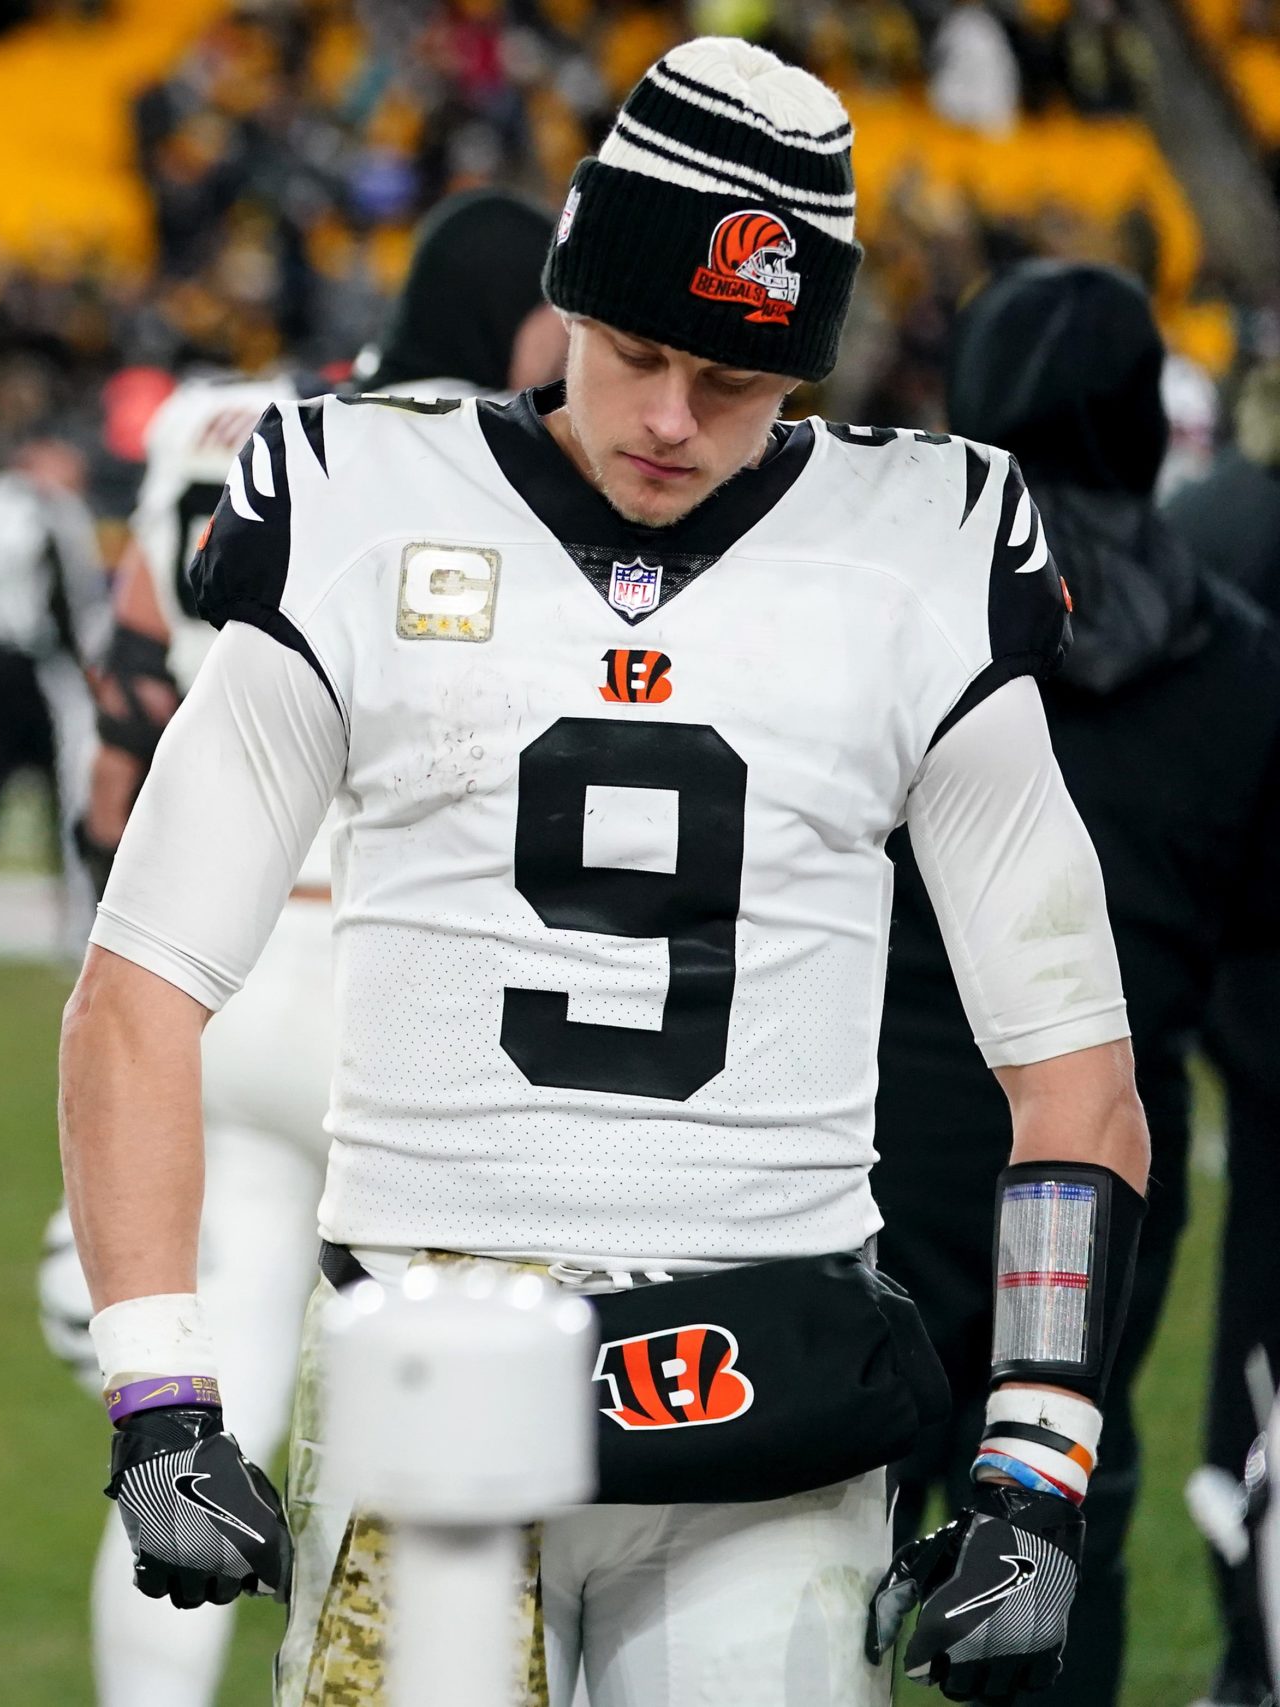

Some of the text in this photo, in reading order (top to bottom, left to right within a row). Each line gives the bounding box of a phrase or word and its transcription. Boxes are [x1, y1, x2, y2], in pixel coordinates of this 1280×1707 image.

[695, 272, 763, 302] BENGALS
[761, 304, 786, 317] AFC
[405, 551, 491, 616] C
[616, 581, 651, 606] NFL
[500, 717, 748, 1101] 9
